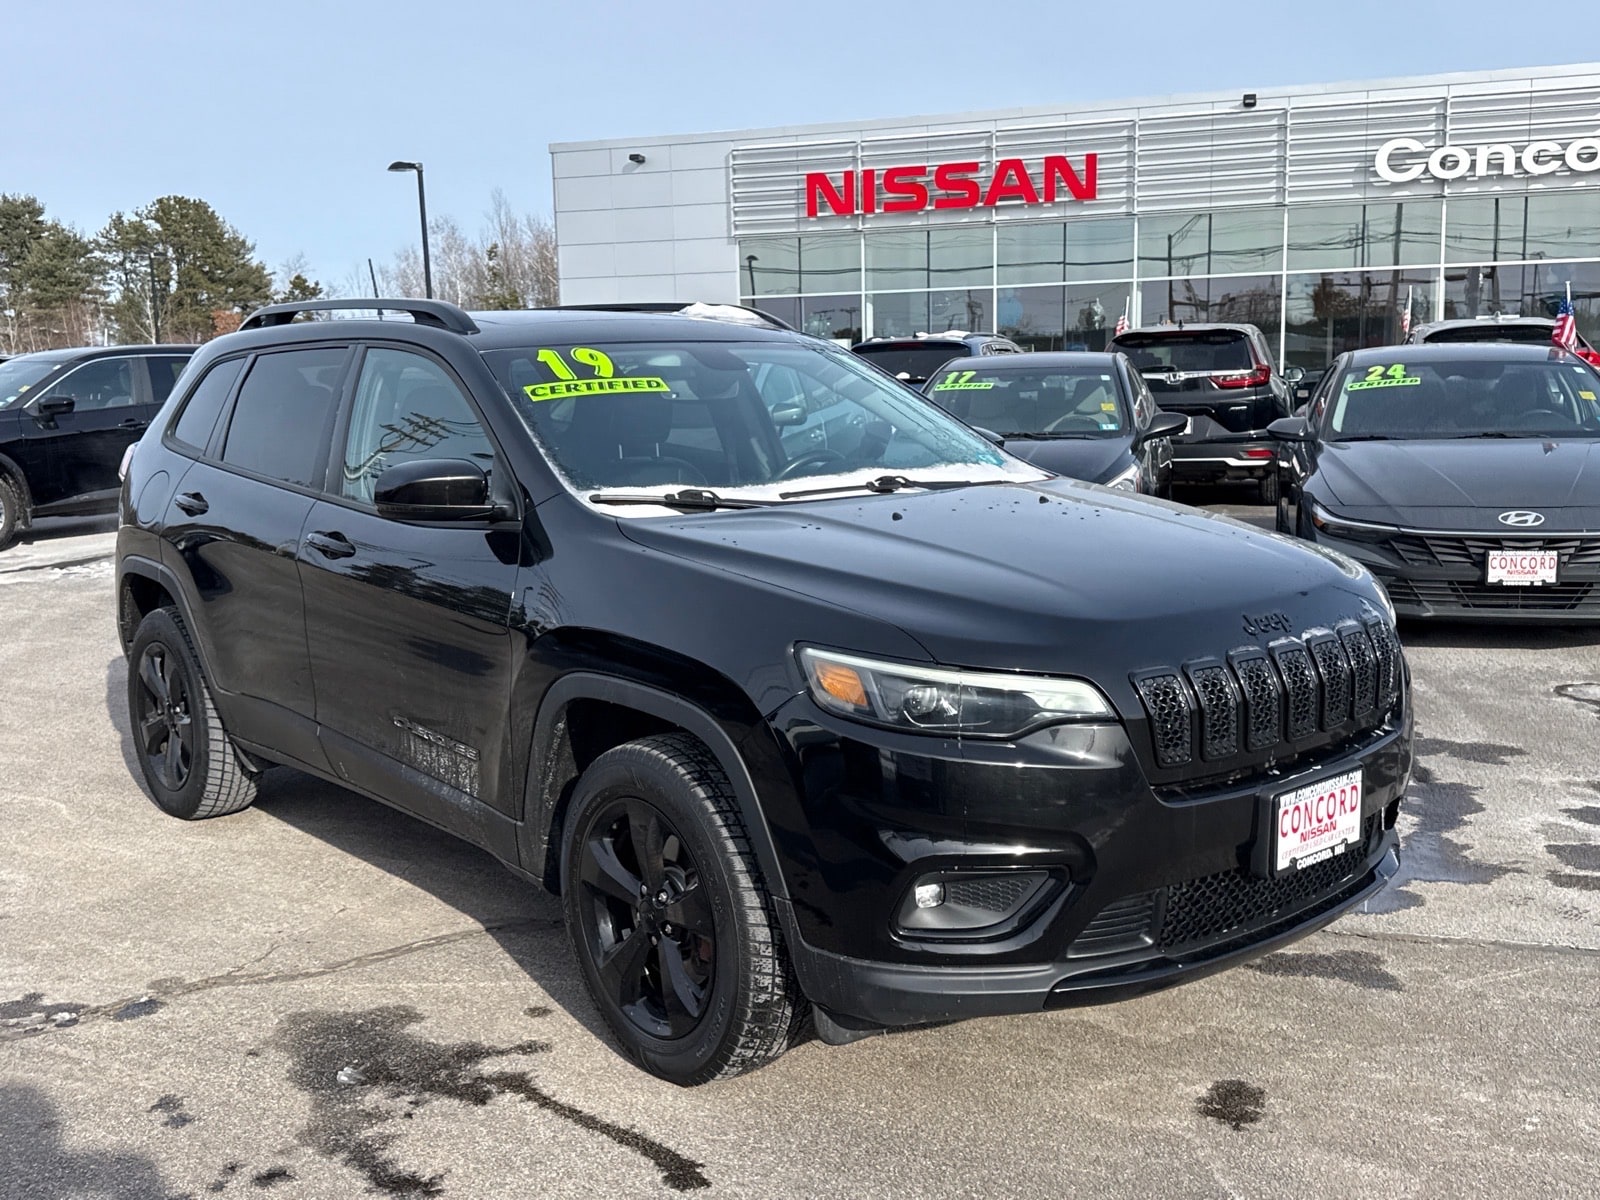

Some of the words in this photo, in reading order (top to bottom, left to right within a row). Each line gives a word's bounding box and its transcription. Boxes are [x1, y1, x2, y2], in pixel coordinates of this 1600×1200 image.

[1374, 137, 1600, 182] Conco
[805, 153, 1098, 217] NISSAN
[537, 347, 614, 380] 19
[1365, 364, 1406, 381] 24
[529, 378, 663, 398] CERTIFIED
[944, 371, 977, 385] 17
[1348, 378, 1419, 390] CERTIFIED
[1490, 557, 1556, 569] CONCORD
[1242, 612, 1292, 636] Jeep
[1280, 784, 1359, 838] CONCORD
[1299, 820, 1337, 843] NISSAN
